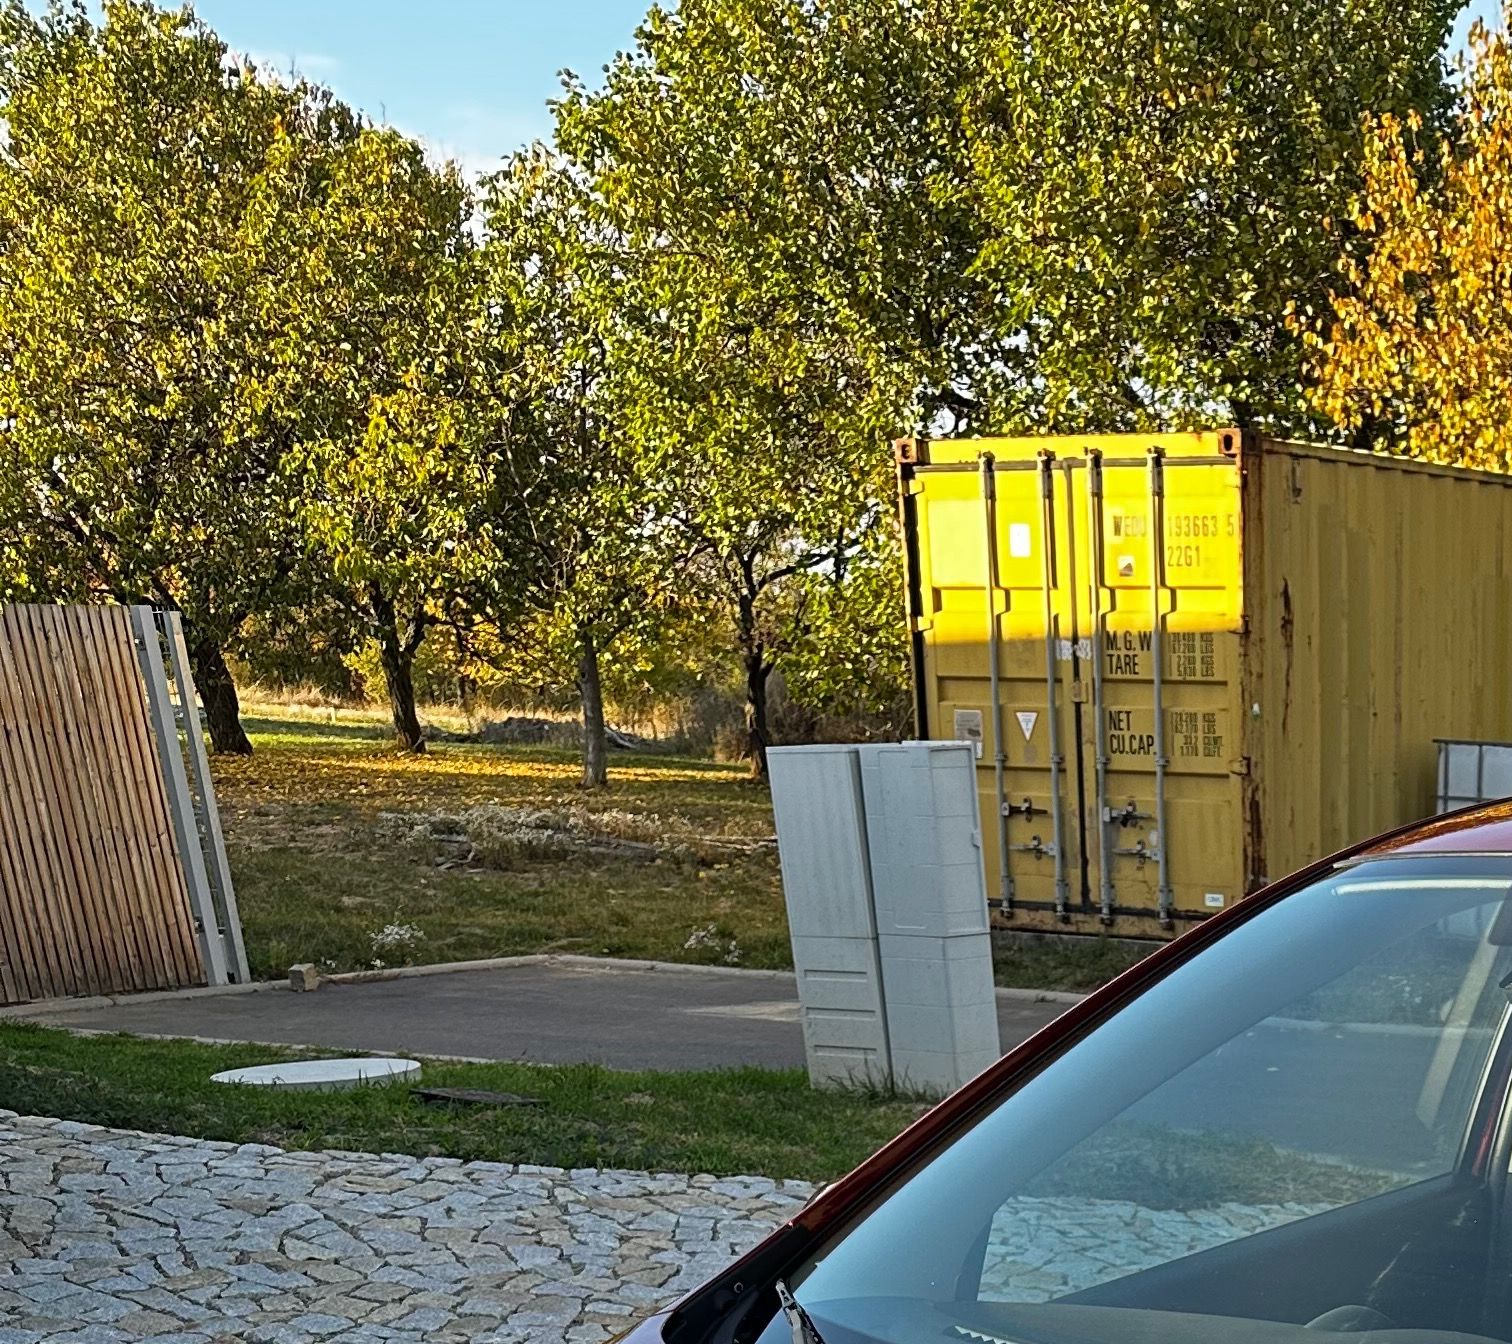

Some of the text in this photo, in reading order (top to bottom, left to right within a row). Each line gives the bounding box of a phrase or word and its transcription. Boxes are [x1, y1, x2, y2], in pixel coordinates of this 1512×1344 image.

[1167, 515, 1218, 537] 193663
[1226, 513, 1235, 537] 5
[1167, 545, 1201, 567] 22G1
[1106, 653, 1140, 676] TARE
[1108, 710, 1133, 732] NET
